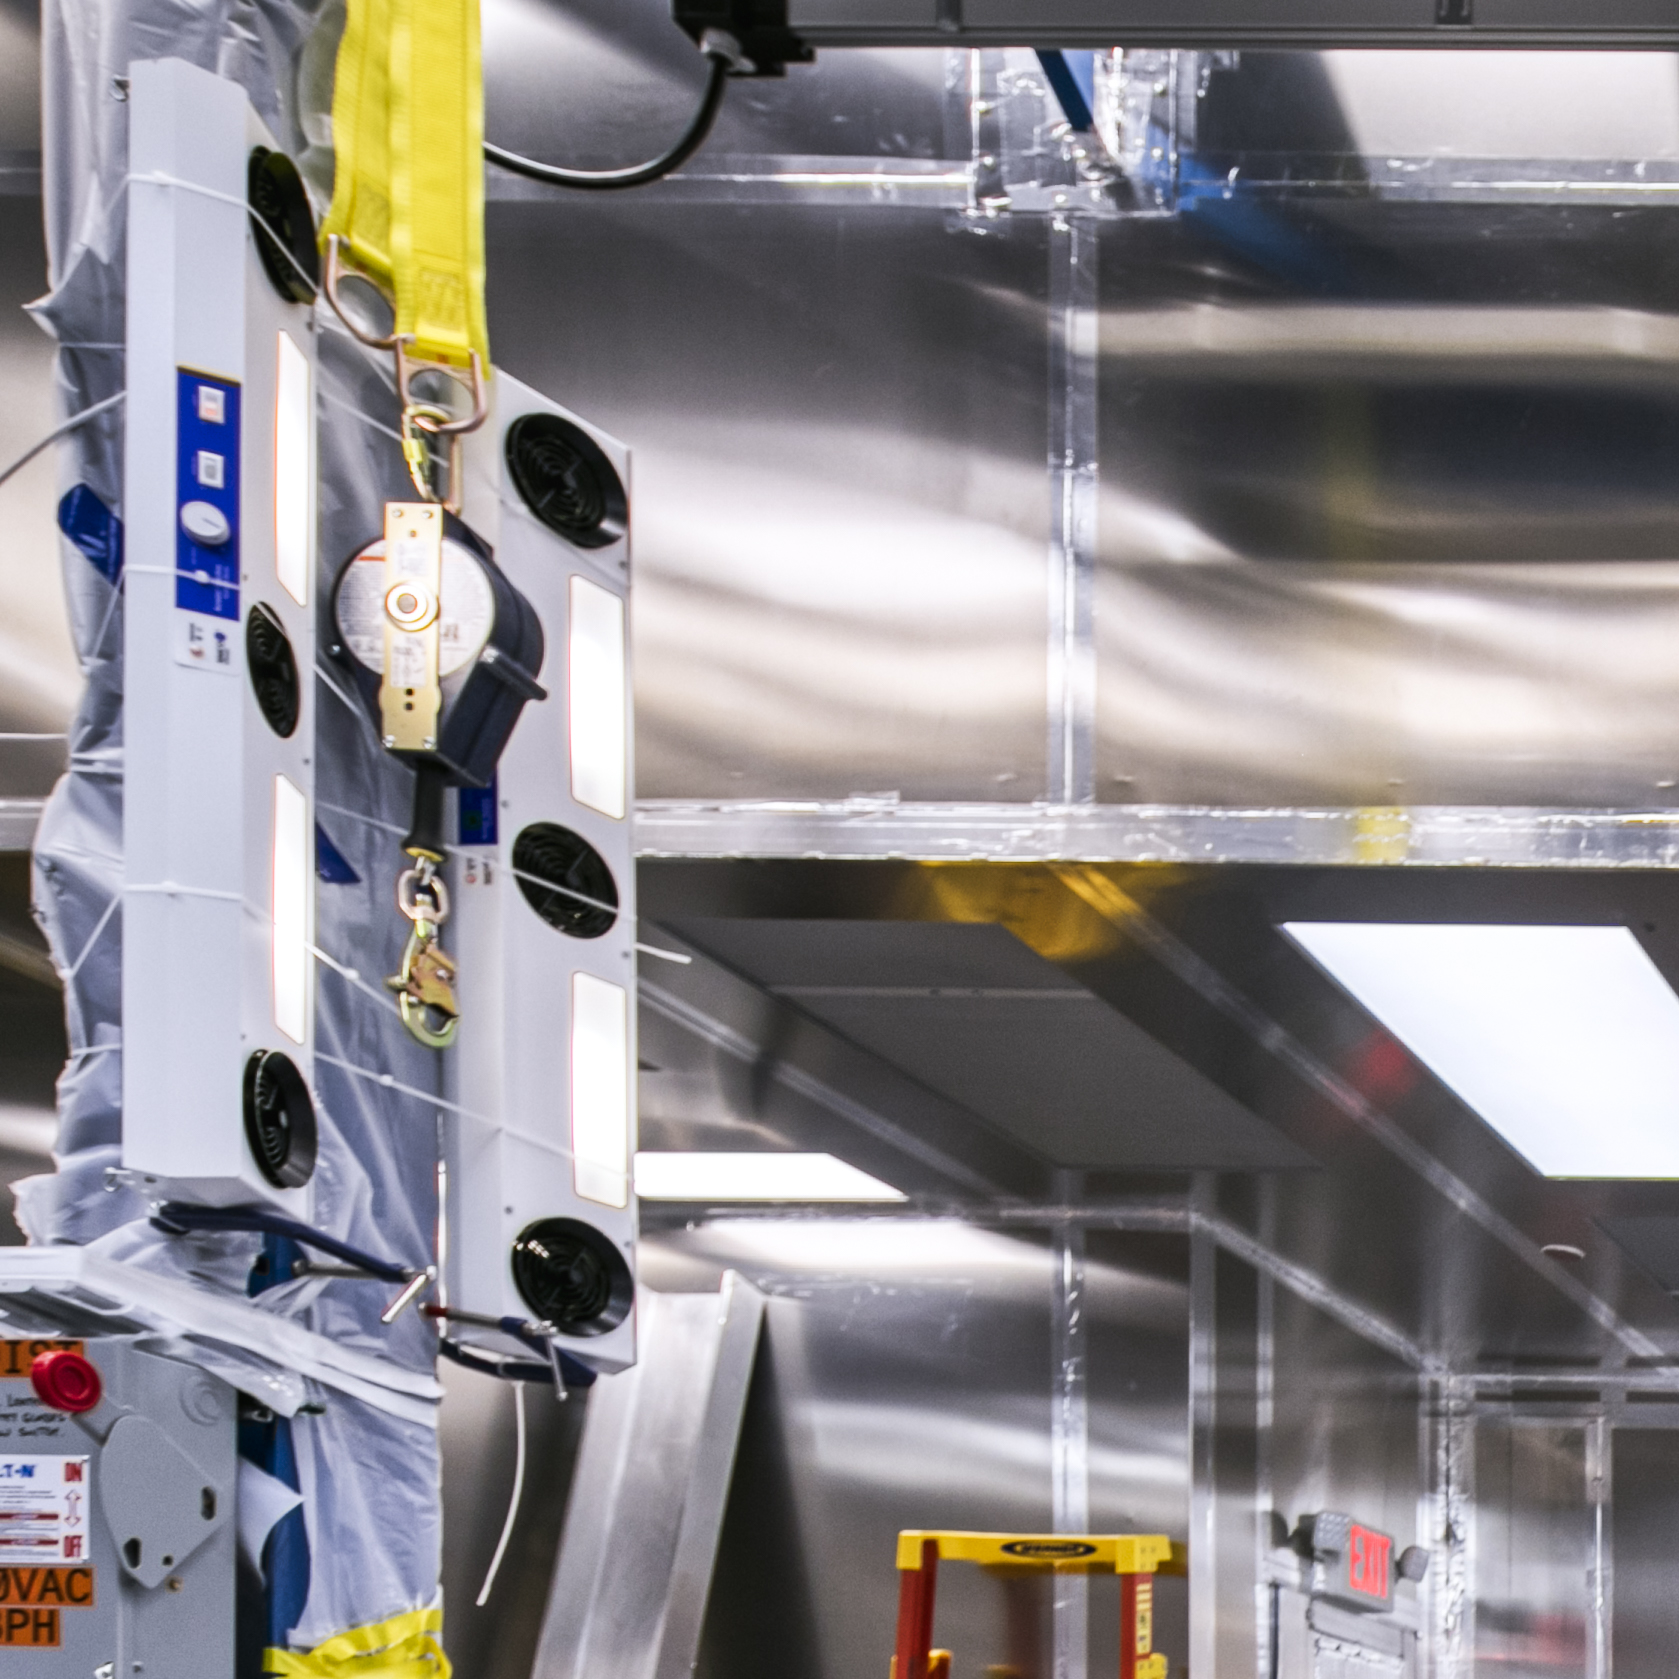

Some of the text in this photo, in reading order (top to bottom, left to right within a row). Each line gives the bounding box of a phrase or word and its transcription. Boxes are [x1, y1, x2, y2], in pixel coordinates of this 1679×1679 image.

[64, 1462, 83, 1482] ON
[64, 1535, 83, 1558] OFF
[1349, 1524, 1391, 1599] EXIT
[0, 1607, 56, 1643] PH
